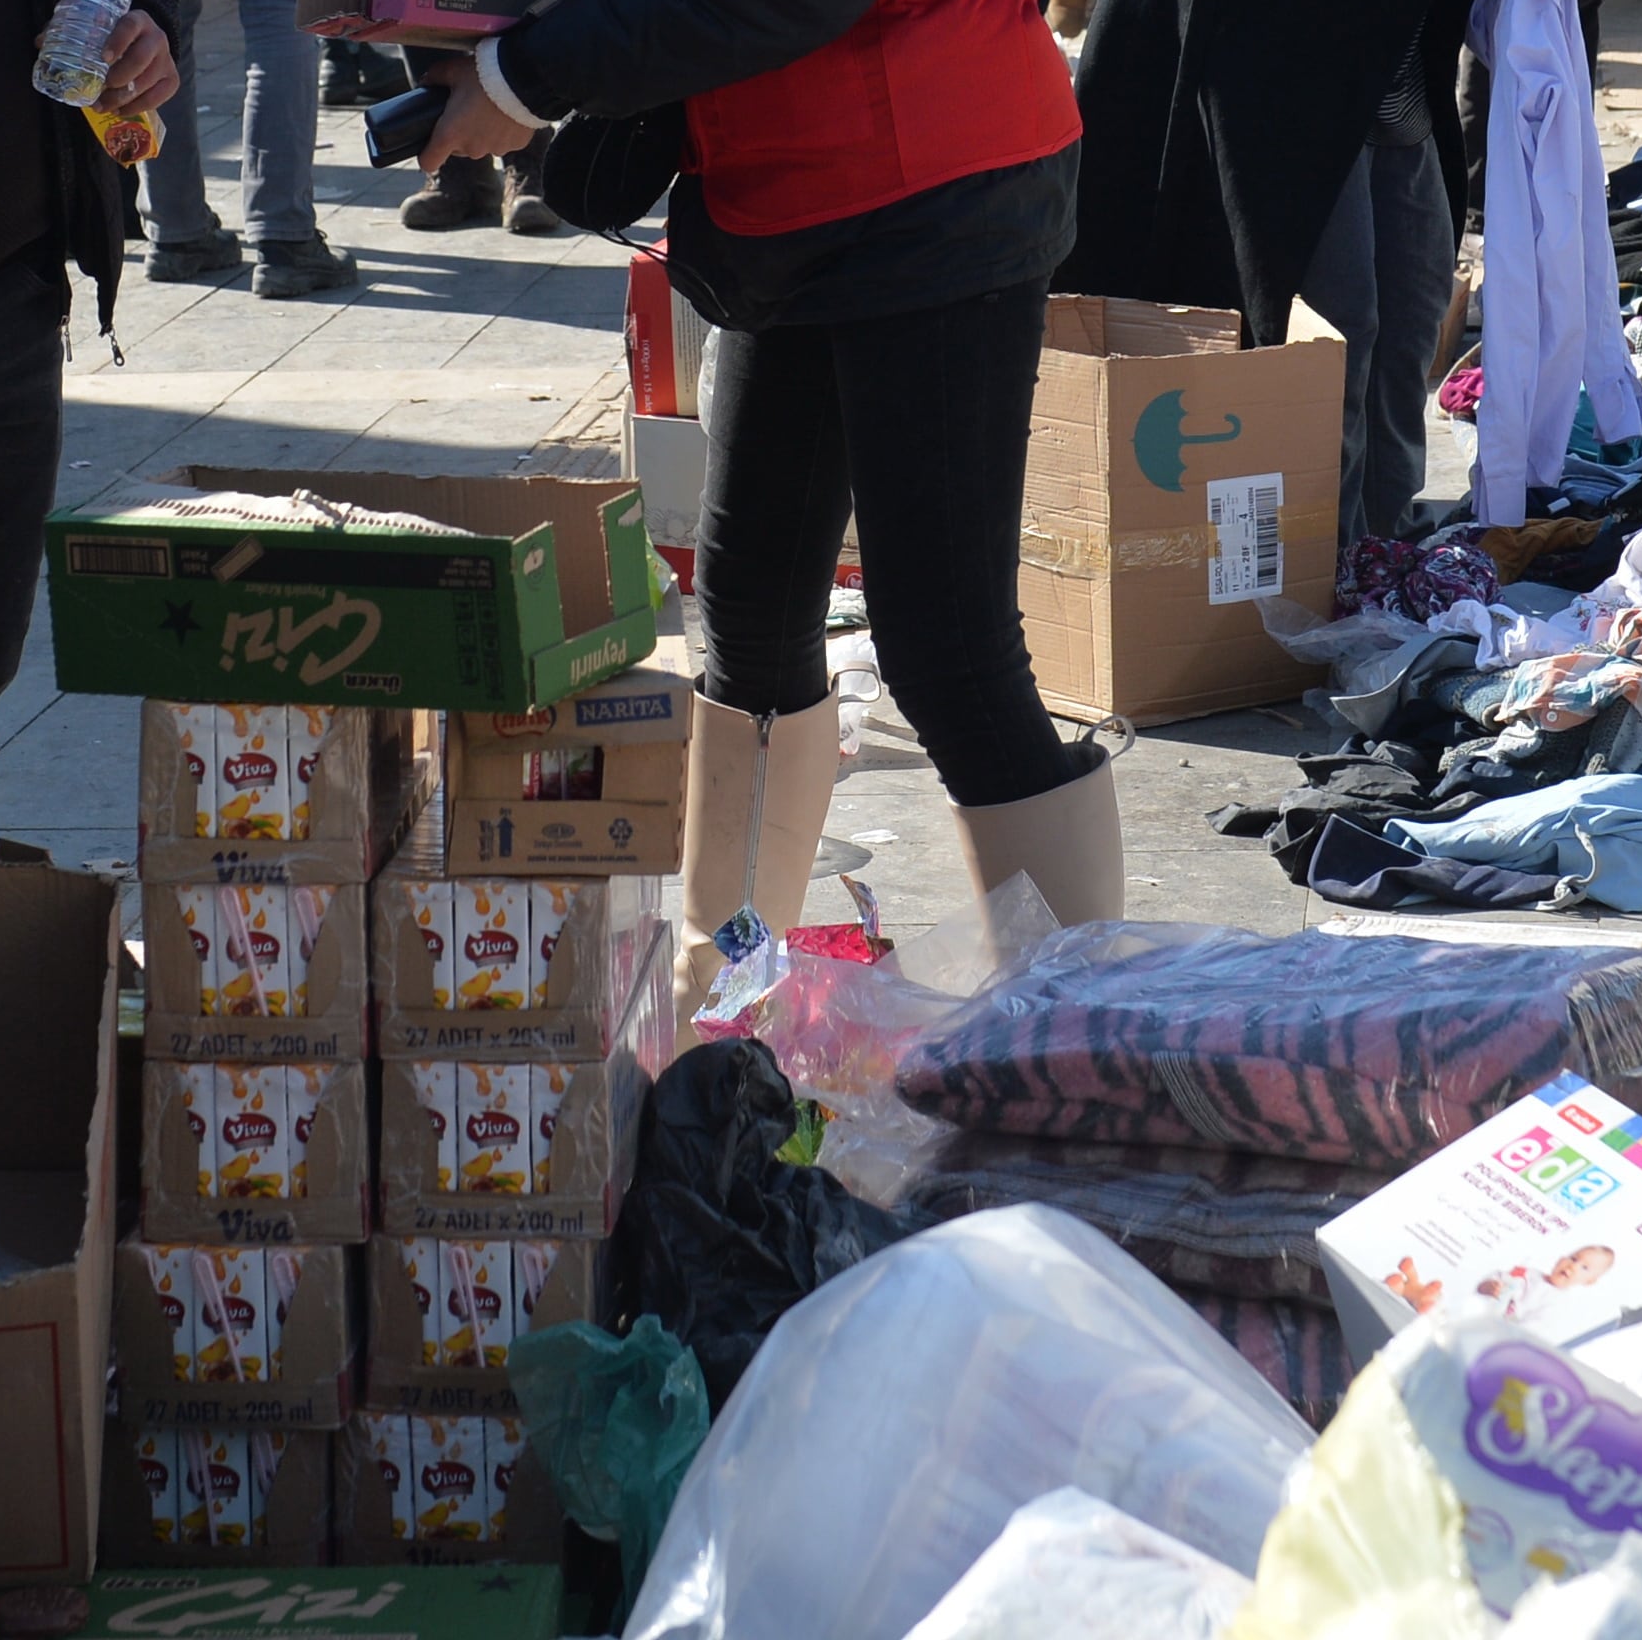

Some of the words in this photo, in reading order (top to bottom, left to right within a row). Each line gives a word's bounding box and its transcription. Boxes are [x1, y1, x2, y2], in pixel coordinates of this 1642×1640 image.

[570, 637, 627, 686] Peynirli
[343, 671, 402, 697] ÜLKER
[581, 695, 666, 722] NARİTA
[228, 761, 272, 779] Viva
[212, 851, 288, 884] Viva
[471, 939, 514, 957] Viva
[171, 1034, 191, 1055] 27
[201, 1033, 246, 1056] ADET
[252, 1041, 264, 1055] x
[271, 1033, 308, 1057] 200
[314, 1033, 338, 1056] ml
[407, 1027, 429, 1049] 27
[437, 1026, 485, 1049] ADET
[490, 1033, 502, 1049] x
[552, 1025, 576, 1048] ml
[229, 1121, 272, 1140] Viva
[472, 1119, 515, 1138] Viva
[1499, 1136, 1617, 1209] eda
[1472, 1161, 1547, 1217] POLİPROPİLEN
[1460, 1170, 1504, 1205] KULPLU
[1501, 1198, 1550, 1236] BİBERON
[218, 1209, 295, 1242] Viva
[415, 1208, 437, 1229] 27
[499, 1216, 509, 1230] x
[517, 1210, 555, 1232] 200
[560, 1210, 585, 1233] ml
[430, 1387, 474, 1408] ADET
[146, 1400, 167, 1422] 27
[176, 1400, 221, 1422] ADET
[226, 1407, 239, 1422] x
[245, 1400, 283, 1423] 200
[289, 1398, 313, 1422] ml
[428, 1471, 469, 1487] Viva
